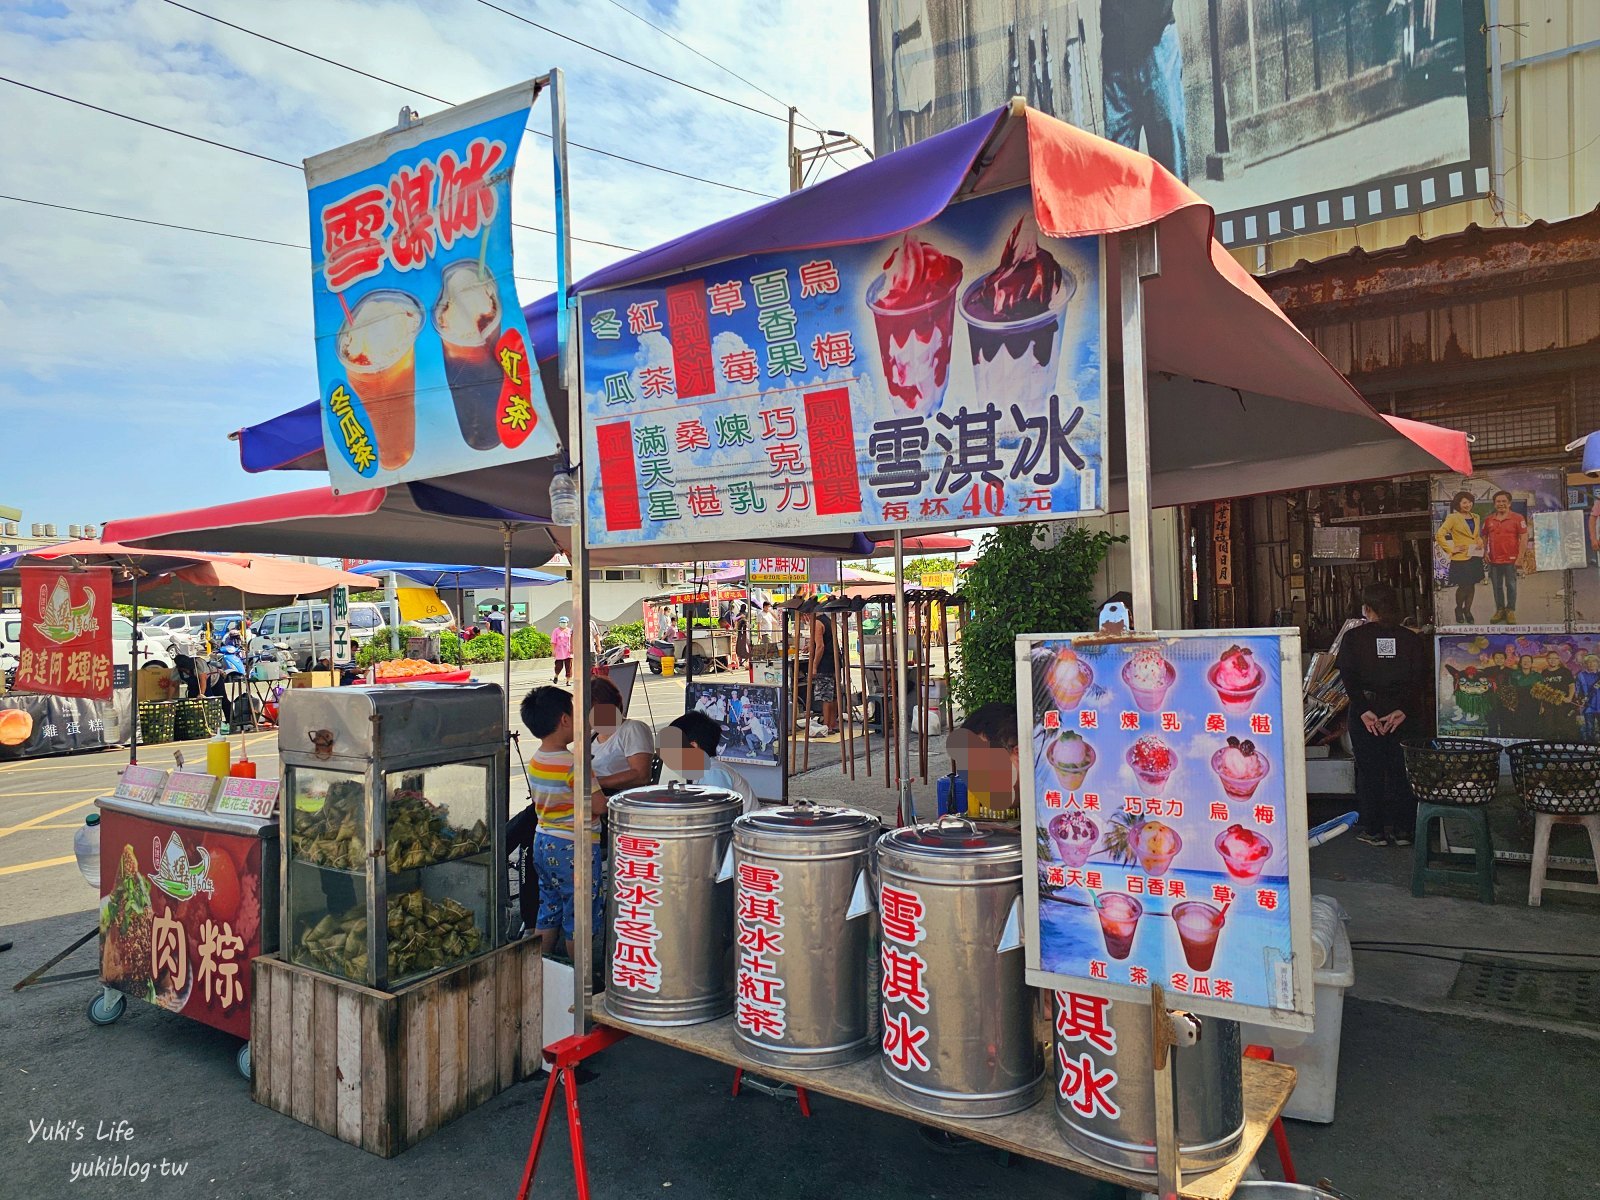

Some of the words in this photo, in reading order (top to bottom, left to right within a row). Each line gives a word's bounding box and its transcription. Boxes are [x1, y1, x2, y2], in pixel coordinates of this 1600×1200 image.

[324, 141, 503, 288] 雪淇冰
[591, 309, 636, 405] 冬瓜
[627, 300, 675, 398] 紅茶
[708, 280, 758, 384] 草莓
[751, 268, 806, 377] 百香果
[800, 260, 855, 370] 烏梅
[329, 384, 377, 474] 冬瓜茶
[500, 346, 531, 432] 紅茶
[634, 425, 681, 521] 滿天星
[675, 420, 723, 517] 桑椹
[715, 412, 766, 513] 煉乳
[758, 406, 810, 511] 巧克力
[868, 394, 1086, 499] 雪淇冰
[18, 647, 111, 692] 興達阿輝粽
[1044, 710, 1098, 730] 鳳梨
[1121, 711, 1182, 732] 煉乳
[1205, 714, 1272, 734] 桑椹
[1045, 790, 1101, 811] 情人果
[1124, 796, 1184, 818] 巧克力
[1210, 802, 1275, 825] 烏梅
[1047, 867, 1103, 889] 滿天星
[1126, 876, 1187, 899] 百香果
[1212, 884, 1279, 910] 草莓
[151, 905, 245, 1009] 肉粽
[881, 886, 929, 1070] 雪淇冰
[1090, 960, 1149, 985] 紅茶
[1171, 972, 1234, 999] 冬瓜茶
